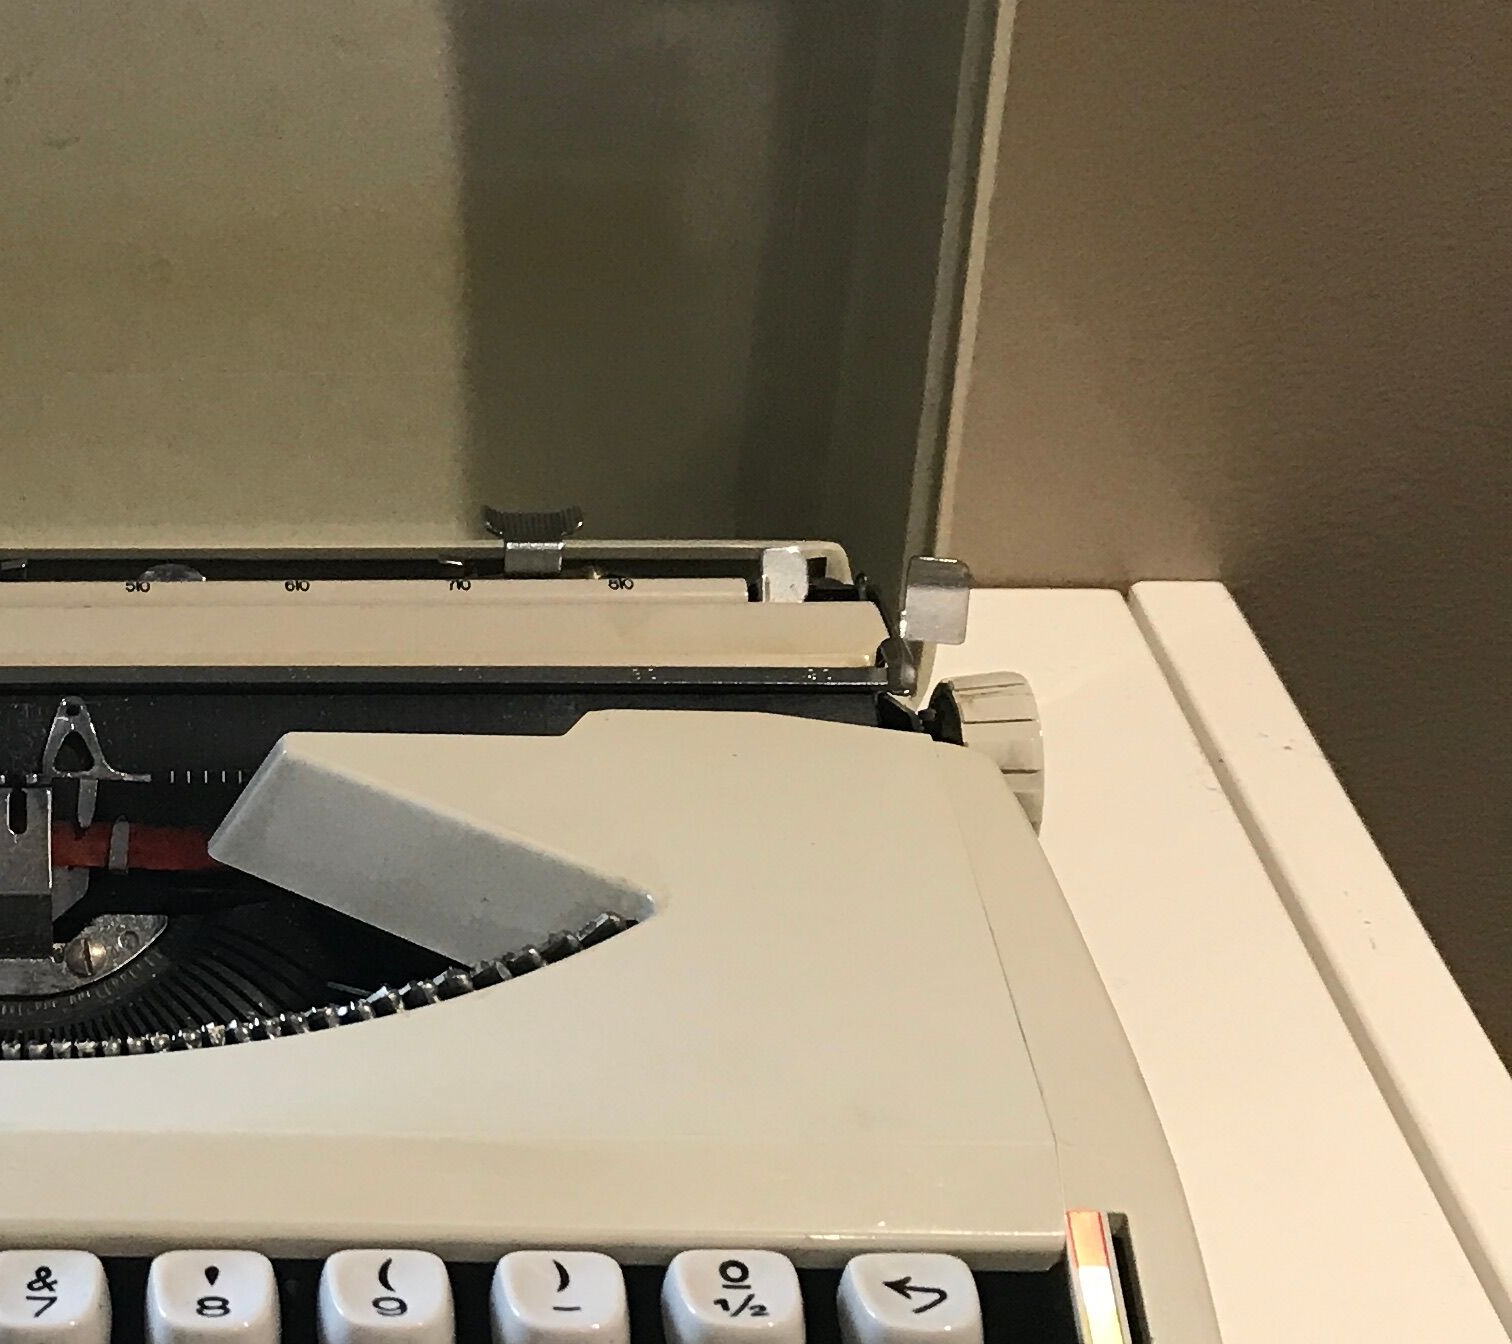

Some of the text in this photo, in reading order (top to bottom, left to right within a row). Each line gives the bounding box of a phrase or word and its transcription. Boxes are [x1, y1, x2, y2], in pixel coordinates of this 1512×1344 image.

[26, 1265, 58, 1292] &
[377, 1258, 395, 1292] (
[553, 1259, 570, 1293] )
[25, 1295, 58, 1318] 7
[195, 1296, 231, 1318] 8
[371, 1296, 408, 1317] 9
